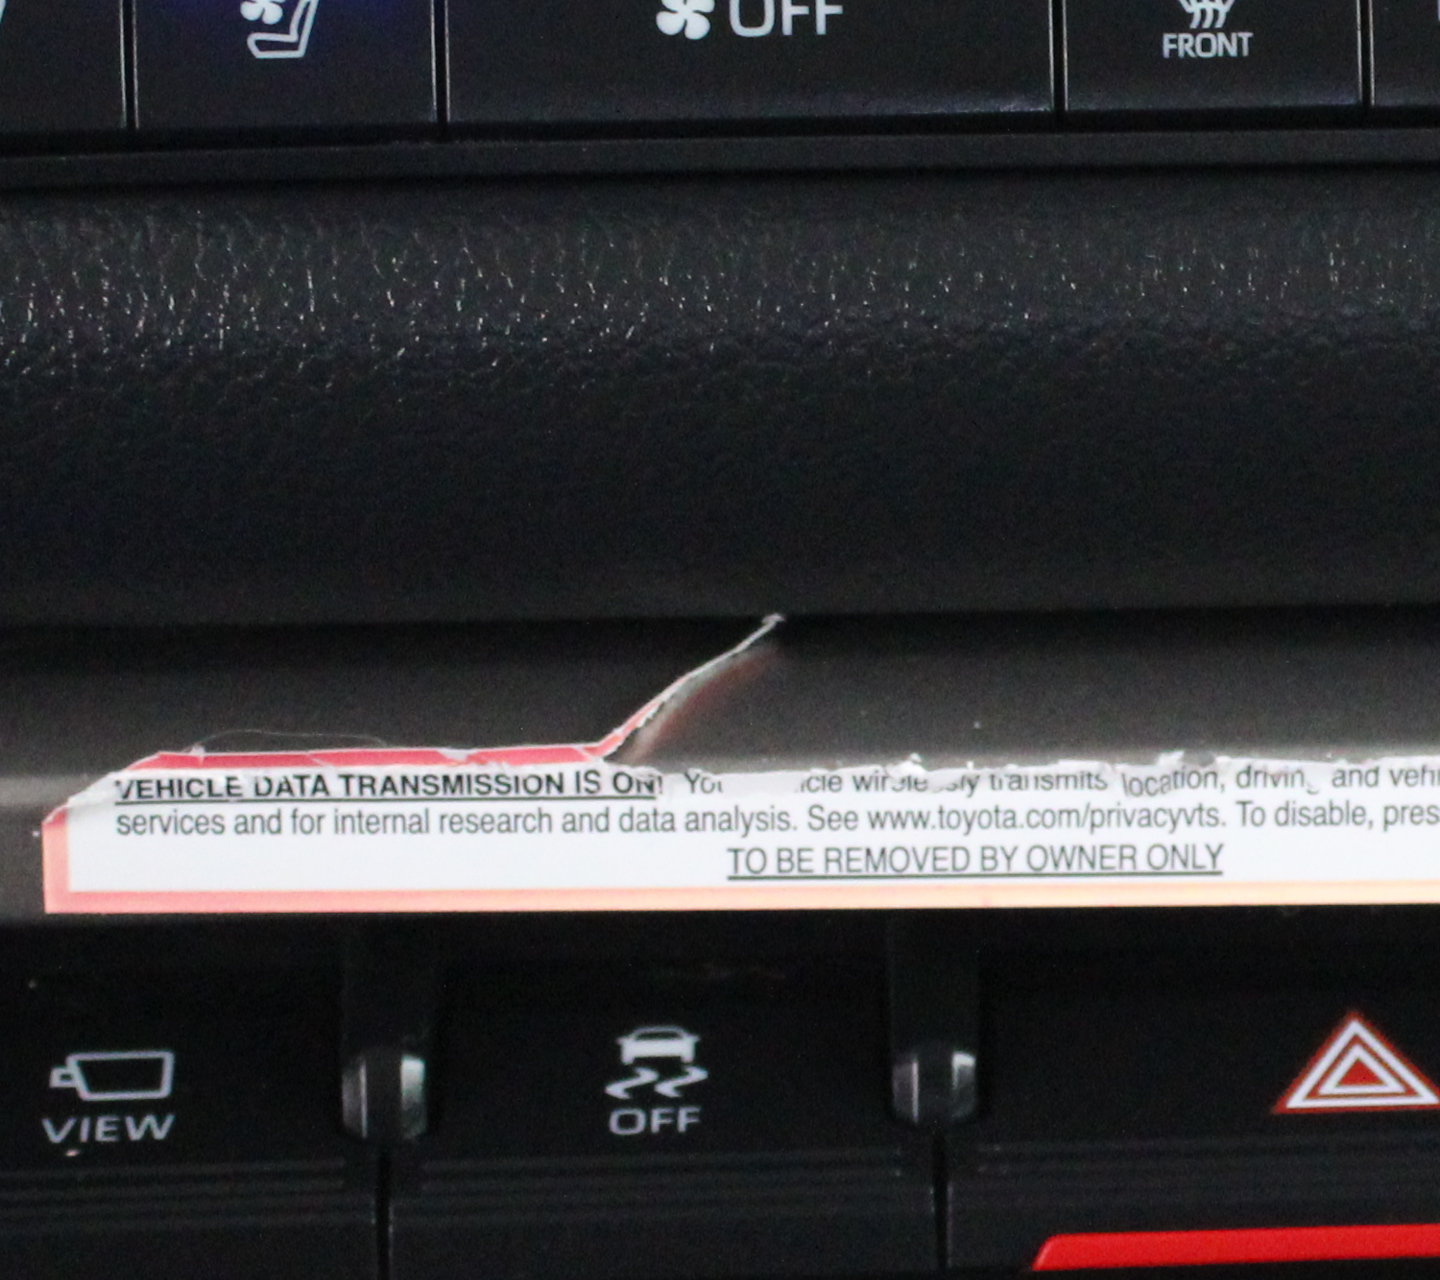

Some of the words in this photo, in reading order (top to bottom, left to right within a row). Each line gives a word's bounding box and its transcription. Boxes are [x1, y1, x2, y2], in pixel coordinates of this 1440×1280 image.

[1163, 32, 1253, 57] FRONT
[116, 776, 243, 798] VEHICLE
[255, 774, 330, 795] DATA
[338, 773, 564, 794] TRANSMISSION
[576, 771, 601, 793] IS
[1121, 764, 1227, 796] location,
[1332, 762, 1380, 788] and
[117, 807, 225, 834] services
[234, 808, 282, 834] and
[291, 807, 326, 834] for
[334, 806, 429, 834] internal
[440, 807, 552, 834] research
[562, 807, 609, 833] and
[619, 807, 676, 832] data
[685, 805, 796, 838] analysis.
[808, 804, 858, 831] See
[867, 803, 1225, 836] www.toyota.com/privacyvts.
[1236, 800, 1266, 827] To
[1274, 800, 1373, 828] disable,
[727, 848, 767, 875] TO
[777, 848, 813, 874] BE
[825, 846, 970, 873] REMOVED
[981, 846, 1018, 873] BY
[1027, 845, 1136, 872] OWNER
[1145, 844, 1223, 872] ONLY
[43, 1115, 173, 1143] VIEW
[610, 1107, 699, 1135] OFF
